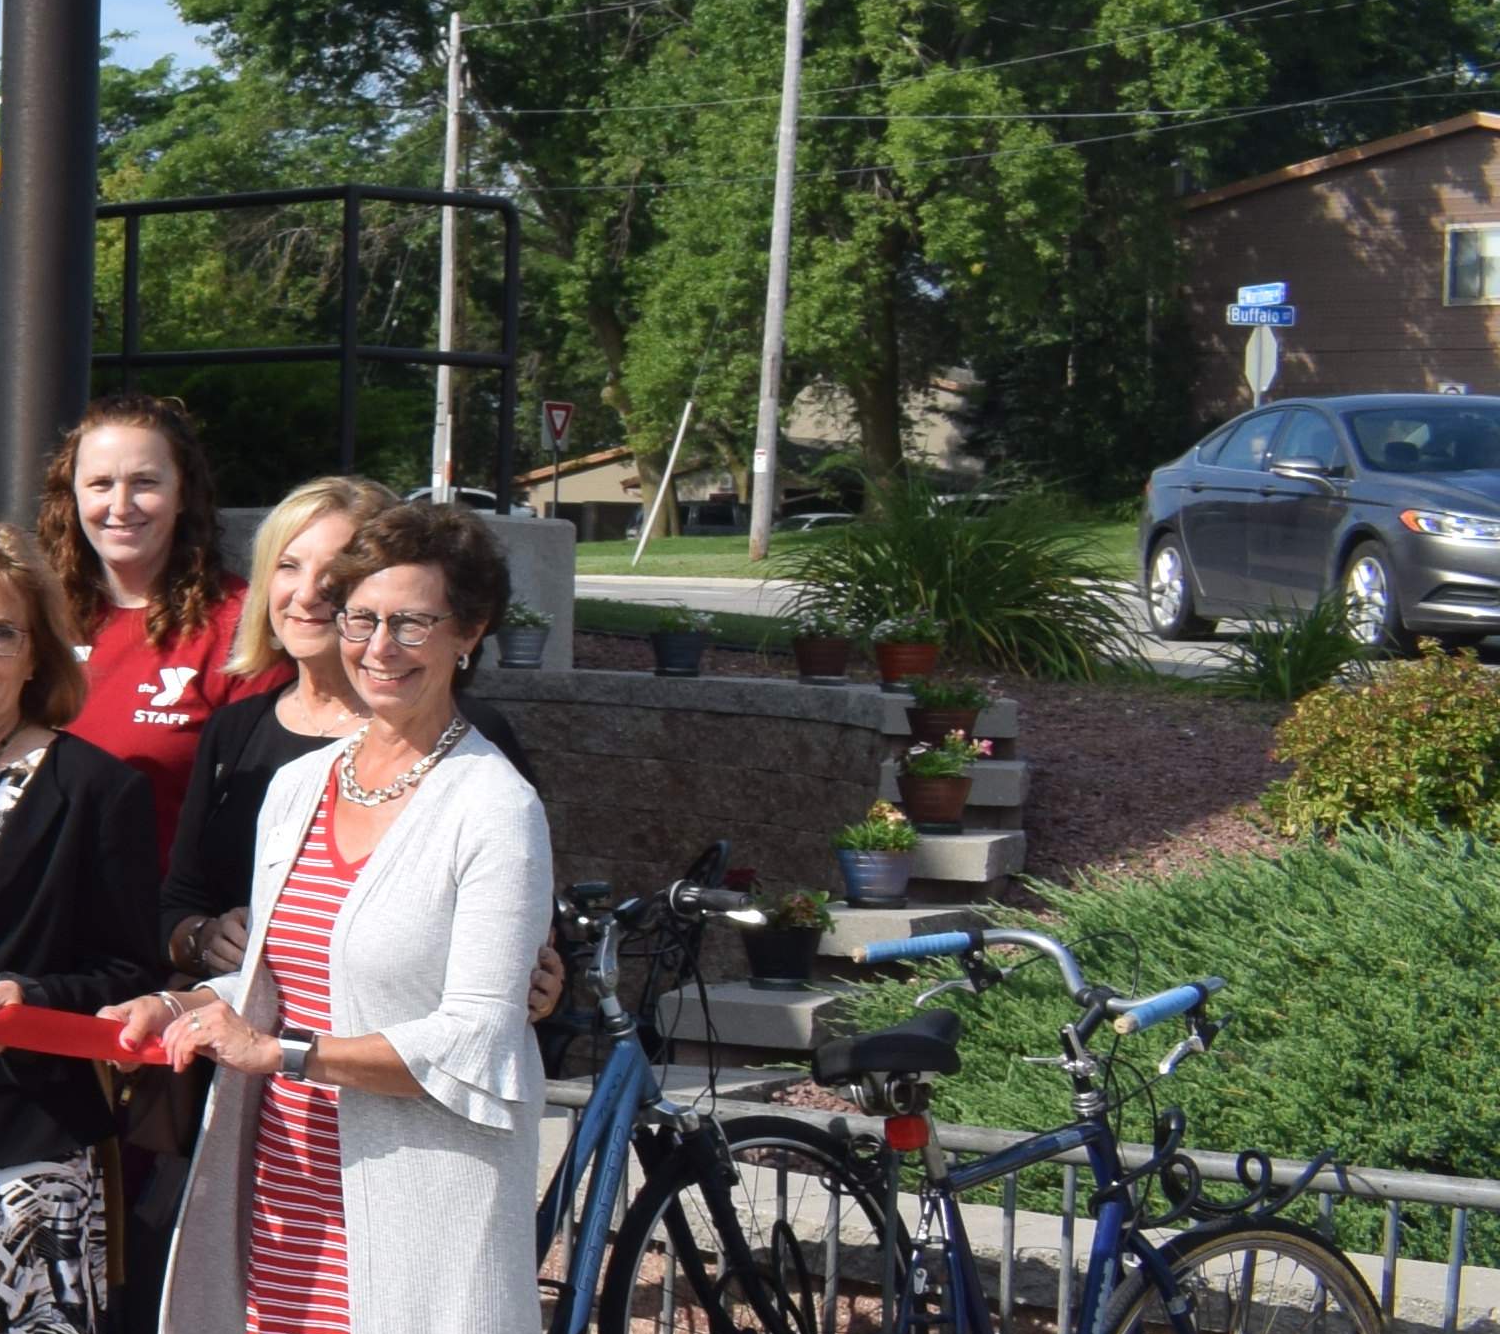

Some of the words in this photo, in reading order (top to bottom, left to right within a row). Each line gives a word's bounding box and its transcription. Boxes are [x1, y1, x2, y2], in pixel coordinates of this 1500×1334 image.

[1231, 307, 1280, 323] Buffalo
[137, 683, 158, 693] the
[133, 709, 190, 725] STAFF
